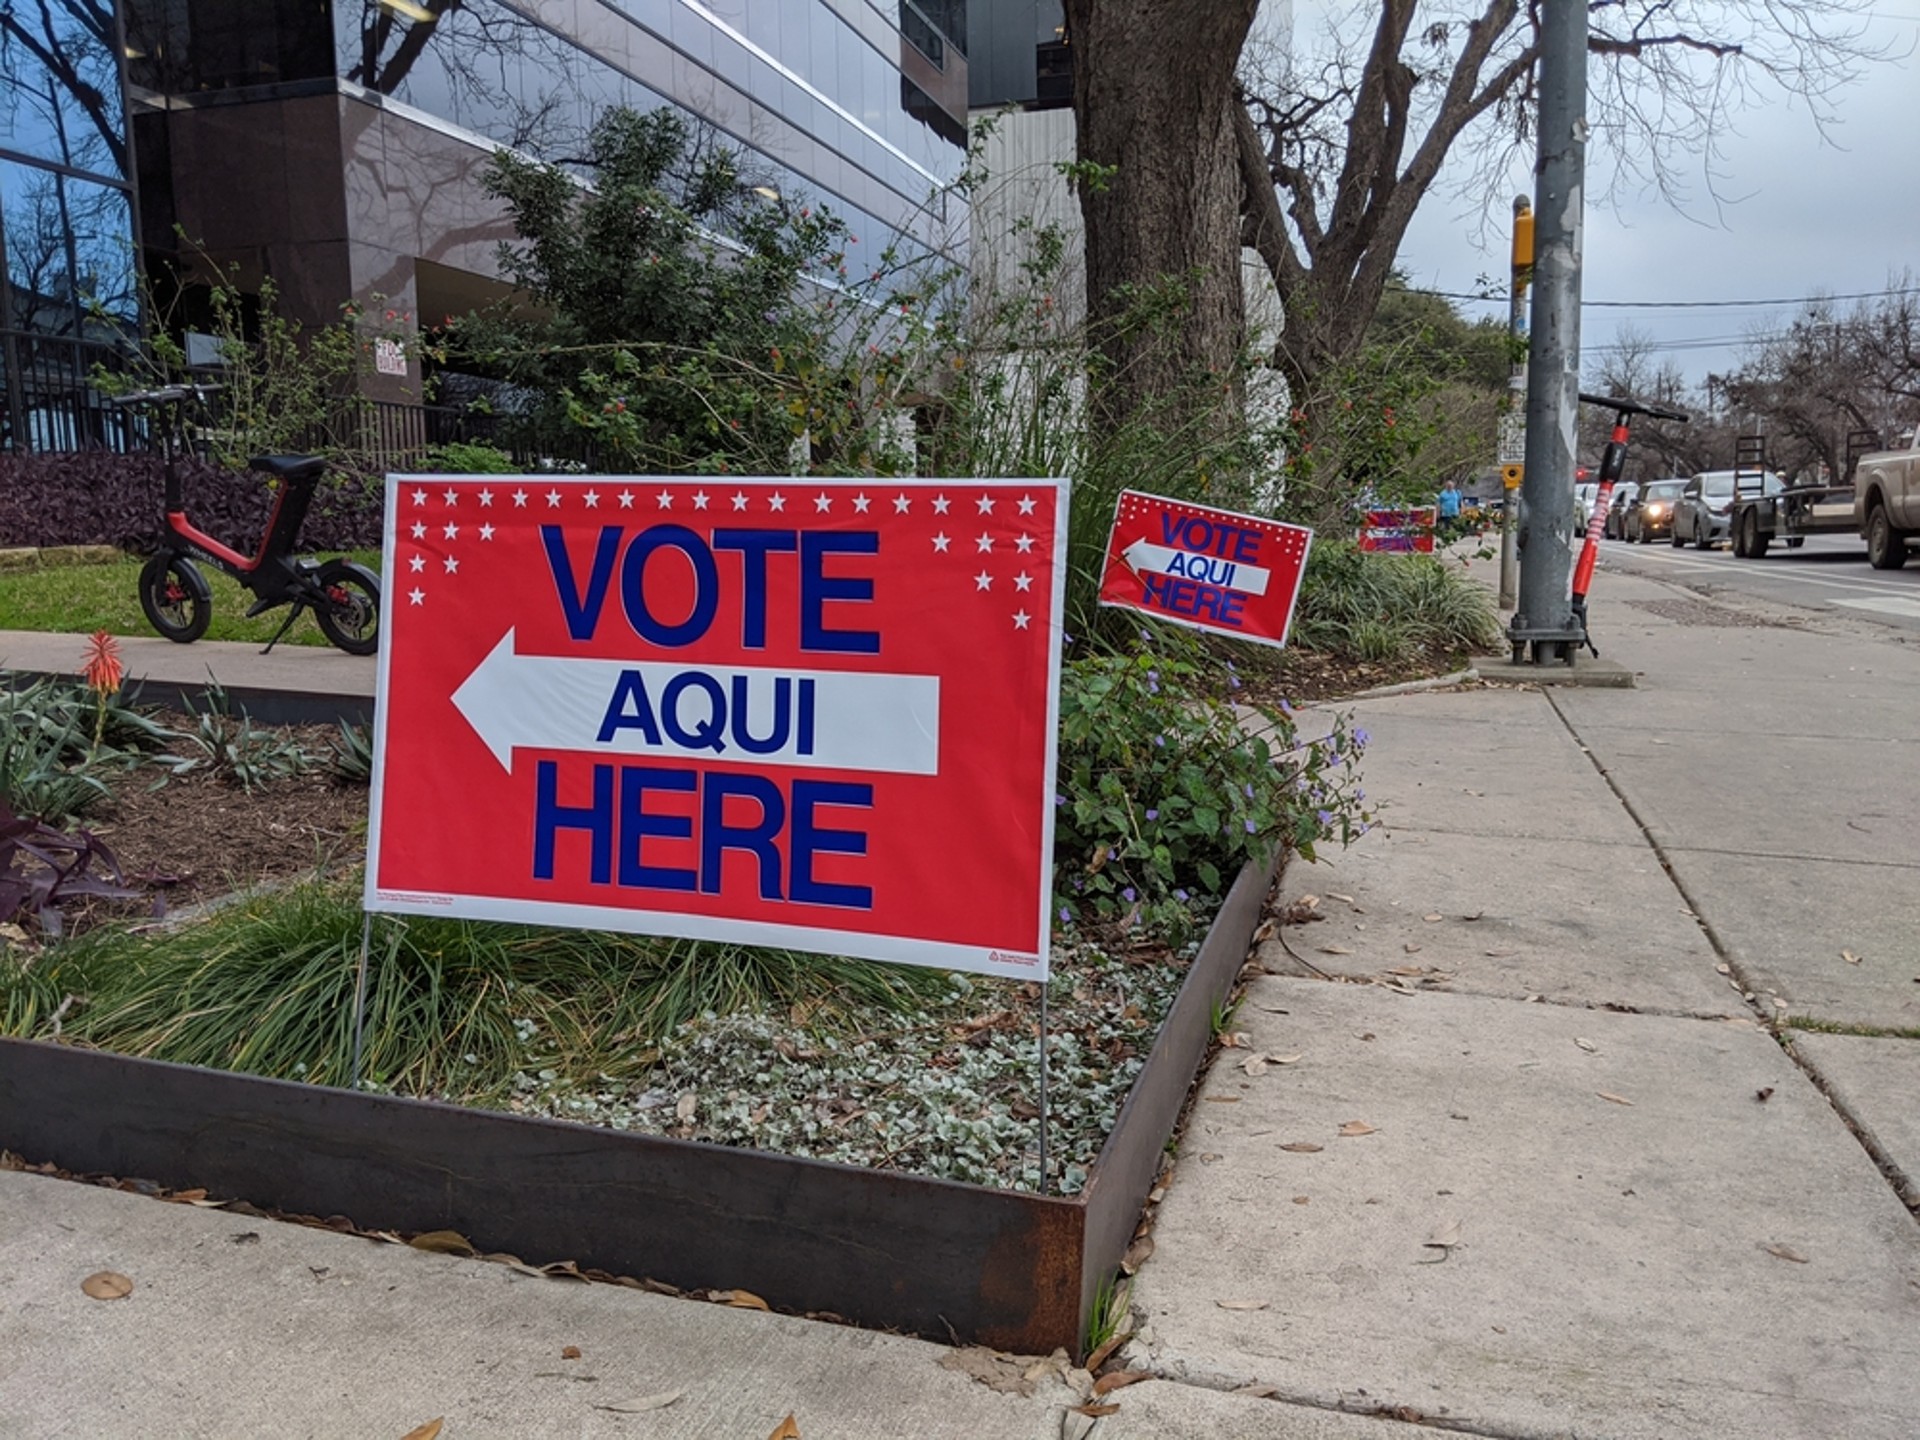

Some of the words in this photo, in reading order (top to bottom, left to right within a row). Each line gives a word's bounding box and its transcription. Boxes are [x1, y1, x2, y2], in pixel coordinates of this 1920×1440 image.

[1162, 512, 1263, 565] VOTE
[1165, 552, 1237, 587] AQUI
[539, 524, 881, 655] VOTE
[1143, 574, 1248, 626] HERE
[596, 669, 816, 756] AQUI
[532, 760, 874, 910] HERE
